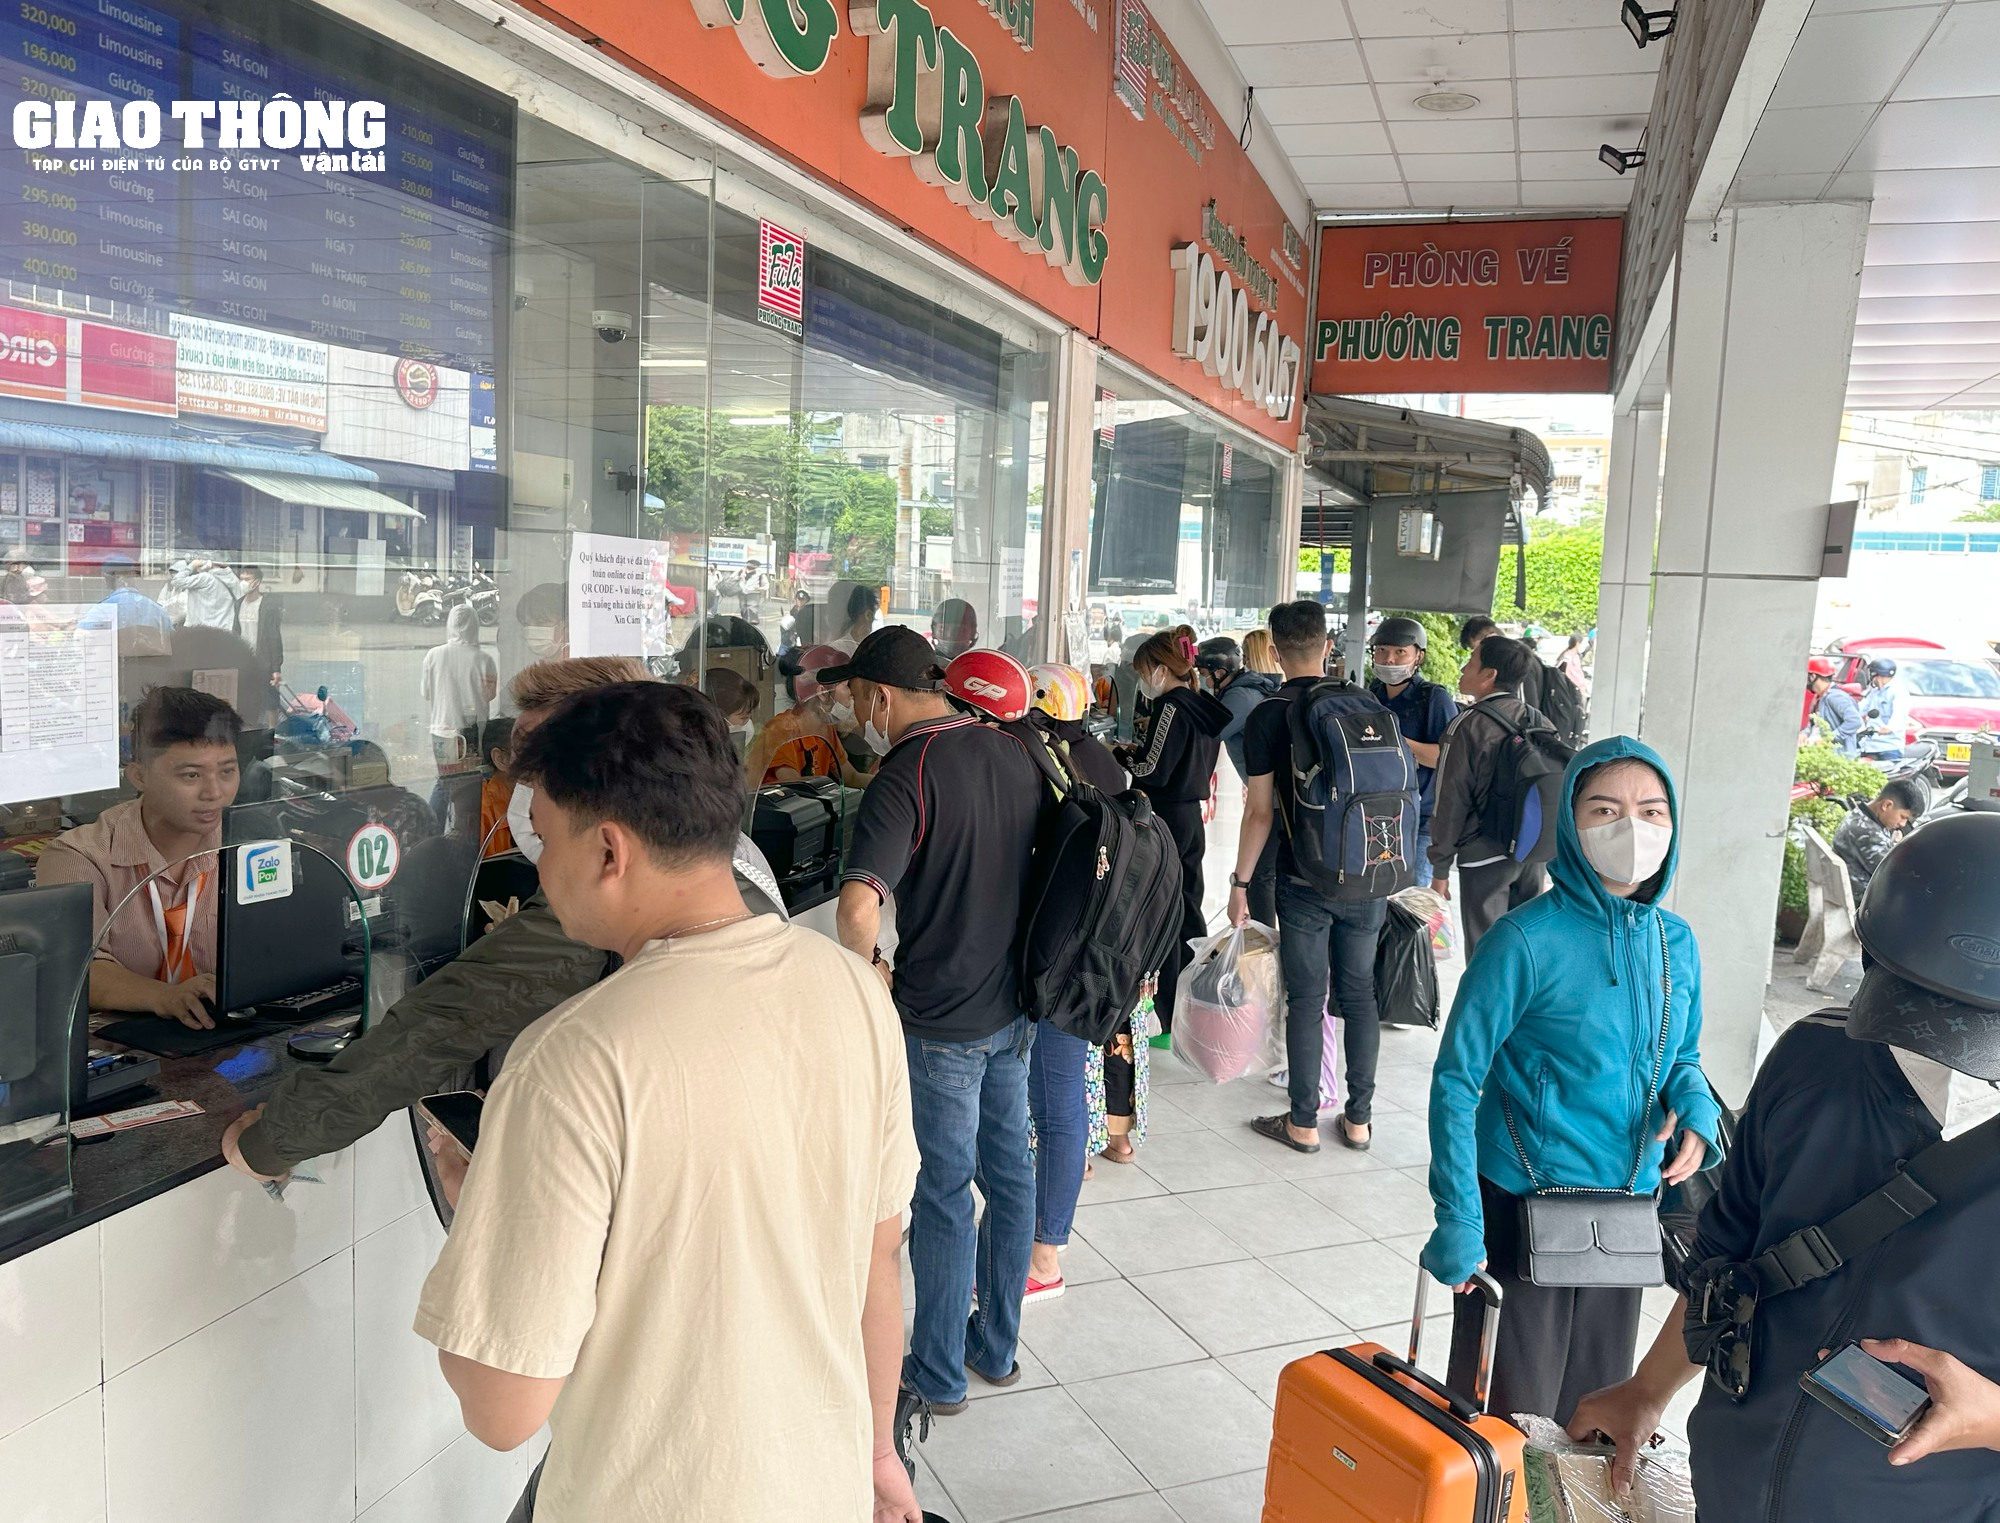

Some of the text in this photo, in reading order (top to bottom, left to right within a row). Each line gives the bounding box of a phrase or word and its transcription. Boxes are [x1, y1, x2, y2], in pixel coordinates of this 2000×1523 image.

[98, 0, 163, 36] Limousine
[20, 4, 163, 70] 320,000 Limousine
[22, 41, 154, 101] 196,000 Giường
[222, 49, 241, 69] SAI
[243, 58, 268, 79] GON
[401, 123, 433, 145] 210,000
[222, 81, 240, 100] SAI
[401, 150, 433, 172] 255,000
[452, 170, 490, 194] Limousine
[856, 0, 1109, 286] TRANG
[22, 174, 155, 212] 295,000 Giường
[222, 176, 241, 194] SAI
[243, 183, 268, 201] GON
[400, 178, 489, 219] 320,000 Limousine
[22, 205, 163, 246] 390,000 Limousine
[222, 207, 241, 224] SAI
[243, 214, 268, 231] GON
[325, 208, 346, 226] NGA
[451, 247, 488, 270] Limousine
[23, 239, 163, 281] 400,000 Limousine
[222, 239, 241, 255] SAI
[243, 244, 268, 262] GON
[325, 237, 346, 254] NGA
[450, 273, 488, 295] Limousine
[222, 269, 241, 286] SAI
[243, 274, 267, 291] GON
[311, 262, 333, 279] NHA
[335, 268, 367, 287] TRANG
[1363, 236, 1573, 288] PHÒNG VÉ
[109, 276, 155, 301] Giường
[222, 302, 240, 317] SAI
[242, 307, 267, 322] GON
[322, 293, 330, 306] O
[332, 296, 356, 313] MON
[757, 307, 783, 329] PHƯƠNG
[783, 317, 803, 337] TRANG
[311, 320, 338, 337] PHAN
[340, 327, 367, 343] THIET
[1315, 311, 1611, 362] PHƯƠNG TRANG
[110, 343, 155, 366] Giường
[579, 551, 594, 565] Quý
[595, 553, 615, 563] khách
[615, 553, 626, 566] đặt
[627, 555, 634, 565] vé
[635, 556, 643, 566] đã
[592, 569, 644, 581] toán online có mã
[581, 583, 644, 597] QR CODE Vui lòng
[581, 600, 592, 609] mã
[593, 597, 611, 611] xuống
[612, 599, 623, 609] nhà
[624, 600, 636, 610] chờ
[614, 615, 626, 624] Xin
[963, 676, 1008, 702] GP
[257, 856, 281, 869] Zalo
[357, 834, 390, 880] 02
[258, 871, 277, 883] Pay
